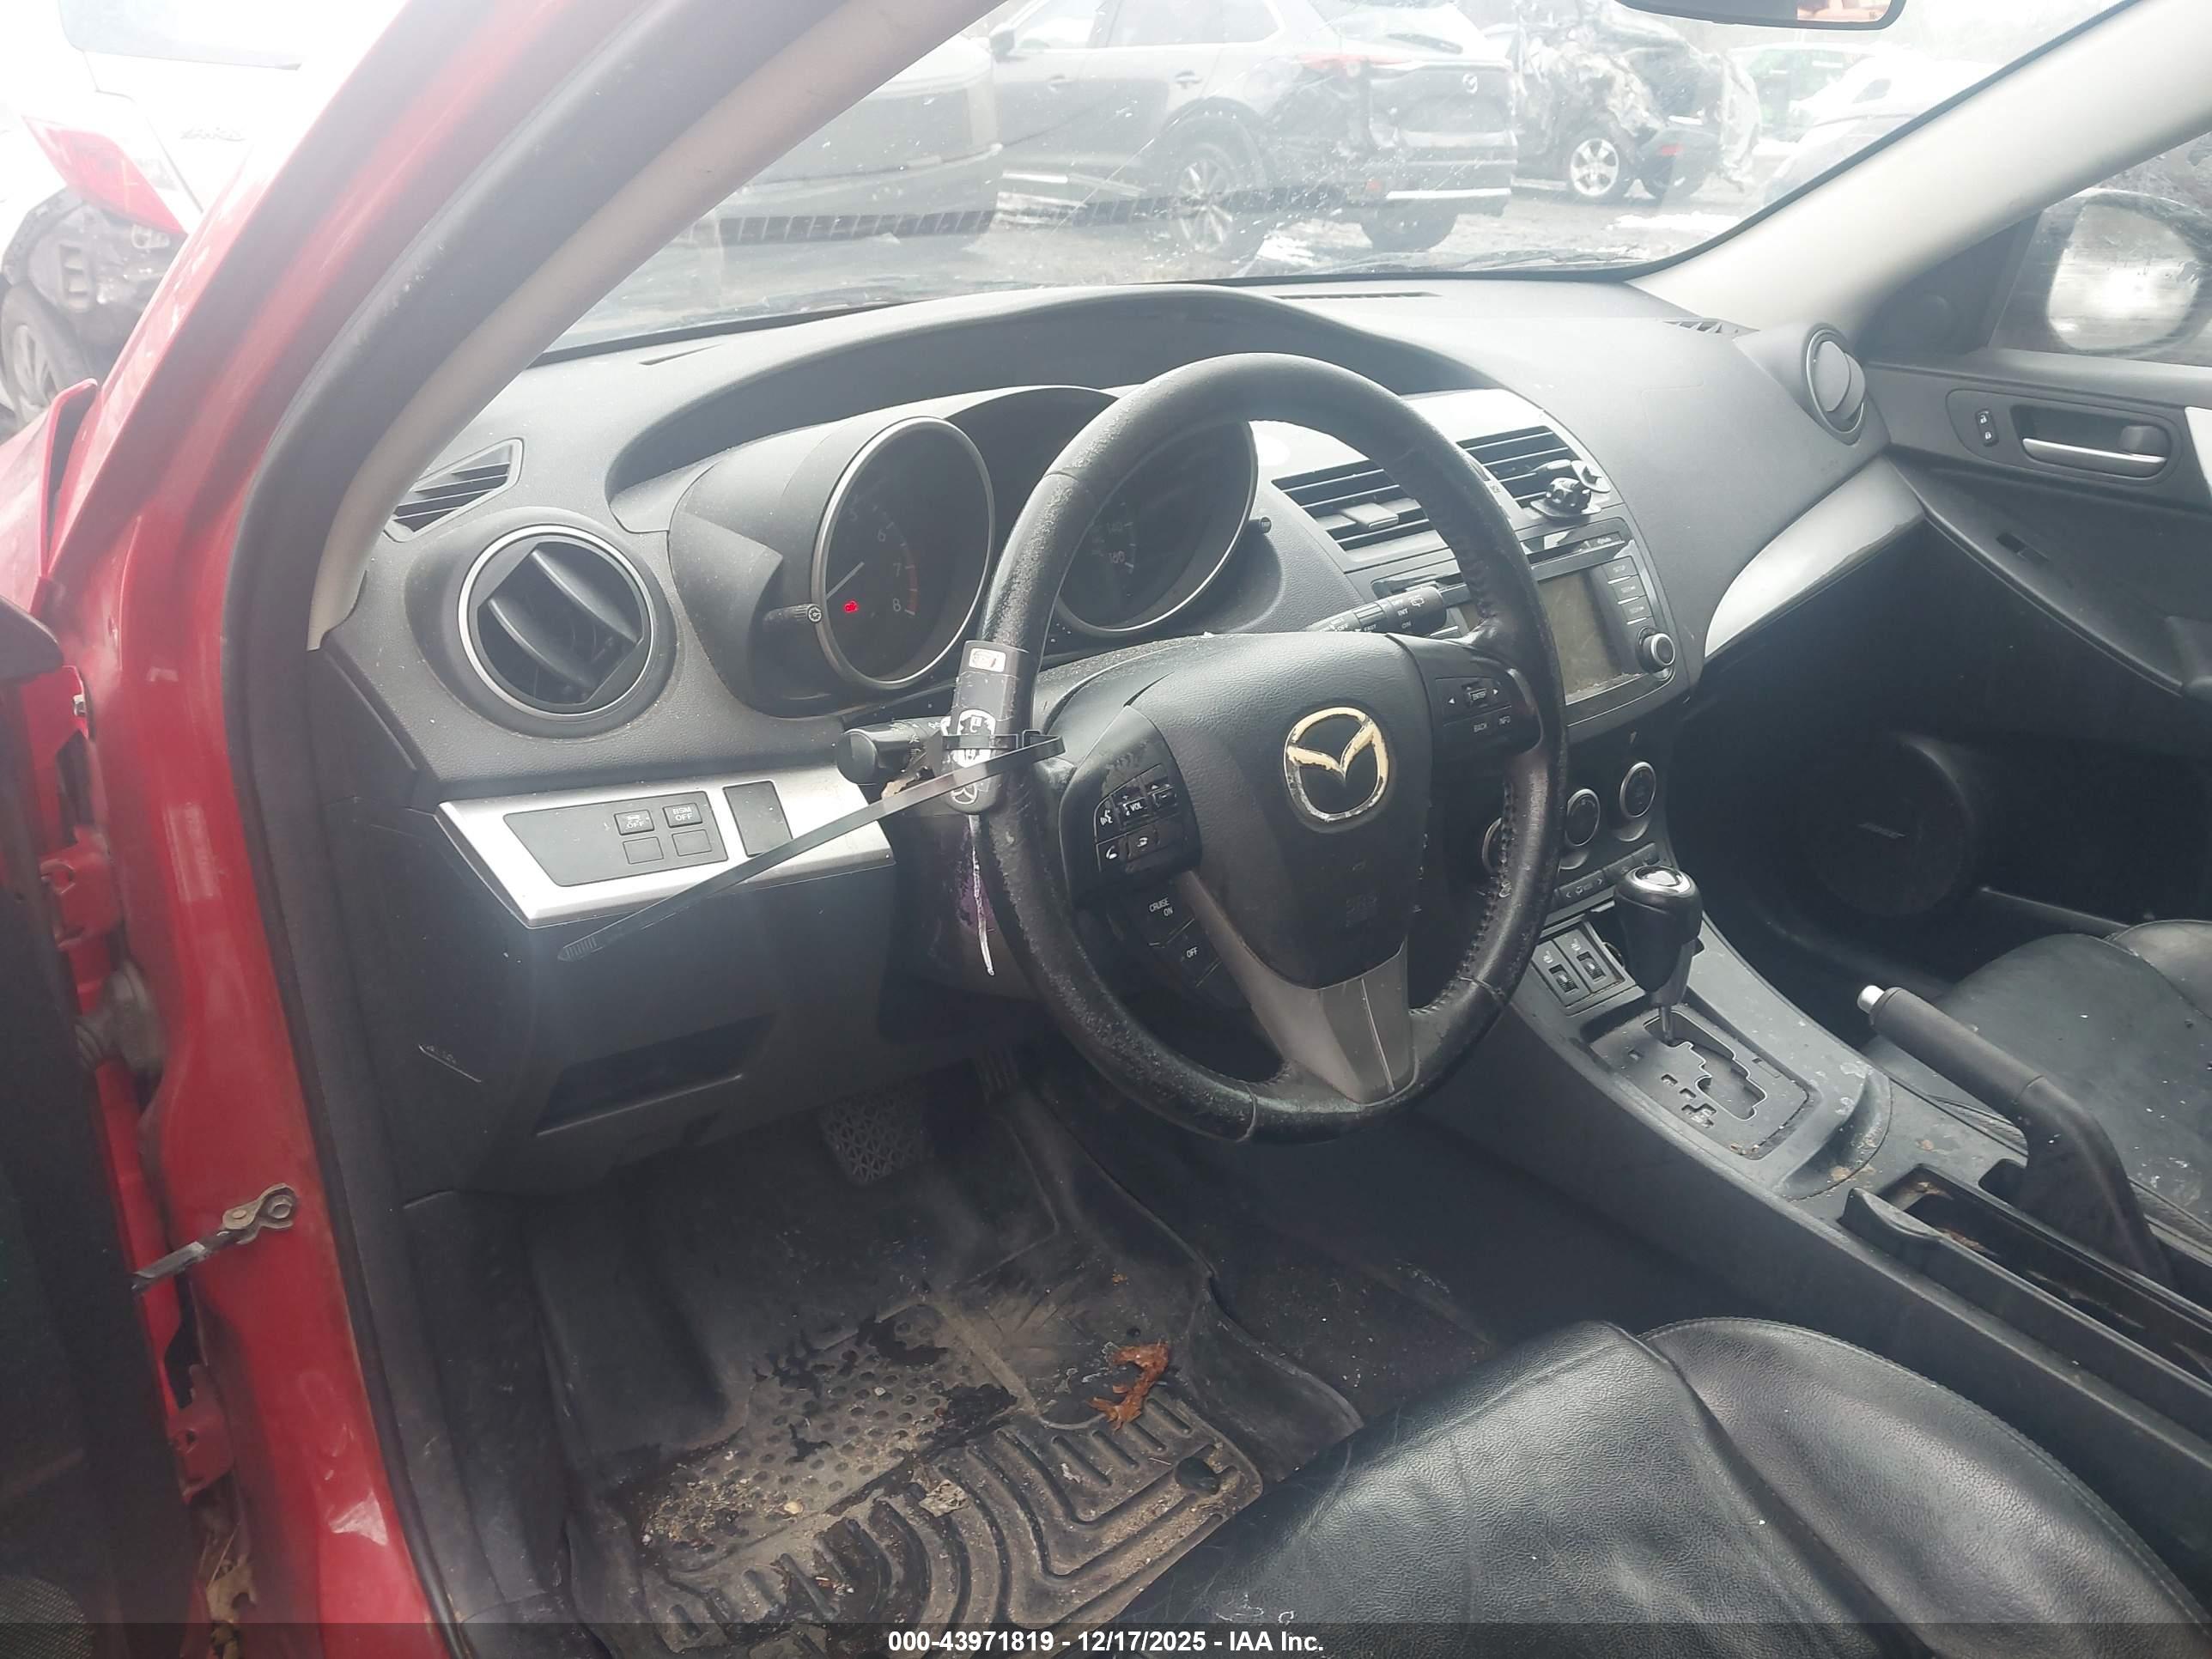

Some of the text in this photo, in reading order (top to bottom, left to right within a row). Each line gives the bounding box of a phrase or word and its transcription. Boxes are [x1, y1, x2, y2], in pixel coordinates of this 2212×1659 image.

[878, 529, 886, 542] 6
[893, 562, 901, 577] 7
[893, 598, 902, 612] 8
[672, 806, 693, 815] BSM
[1130, 802, 1144, 811] VOL
[675, 812, 694, 822] OFF
[626, 820, 646, 829] OFF
[1149, 896, 1170, 913] CRUISE
[1163, 906, 1174, 916] ON
[1186, 946, 1198, 958] OFF
